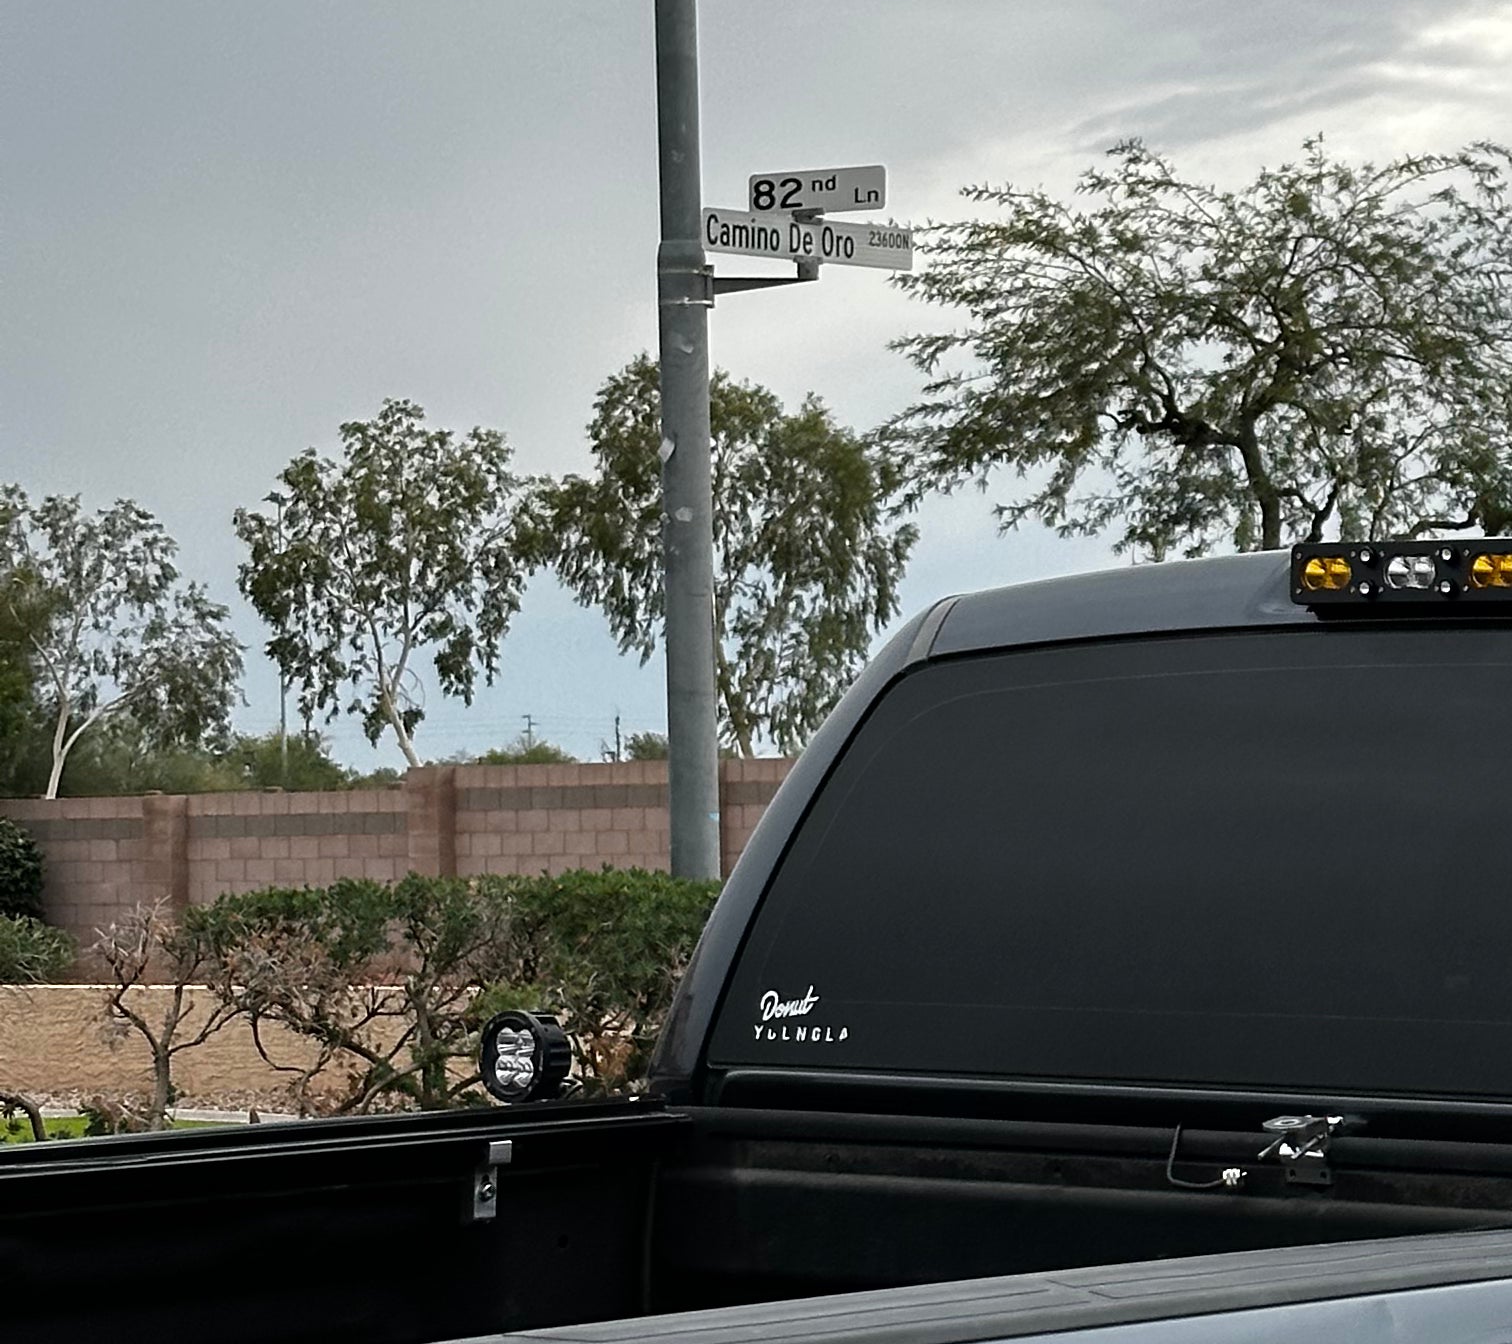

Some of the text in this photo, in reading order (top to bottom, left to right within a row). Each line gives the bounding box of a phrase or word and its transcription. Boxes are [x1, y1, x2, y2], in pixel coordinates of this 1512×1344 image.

[854, 187, 880, 204] Ln
[706, 214, 780, 252] Camino
[789, 223, 814, 256] De
[822, 226, 854, 259] Oro
[760, 984, 820, 1022] Donut
